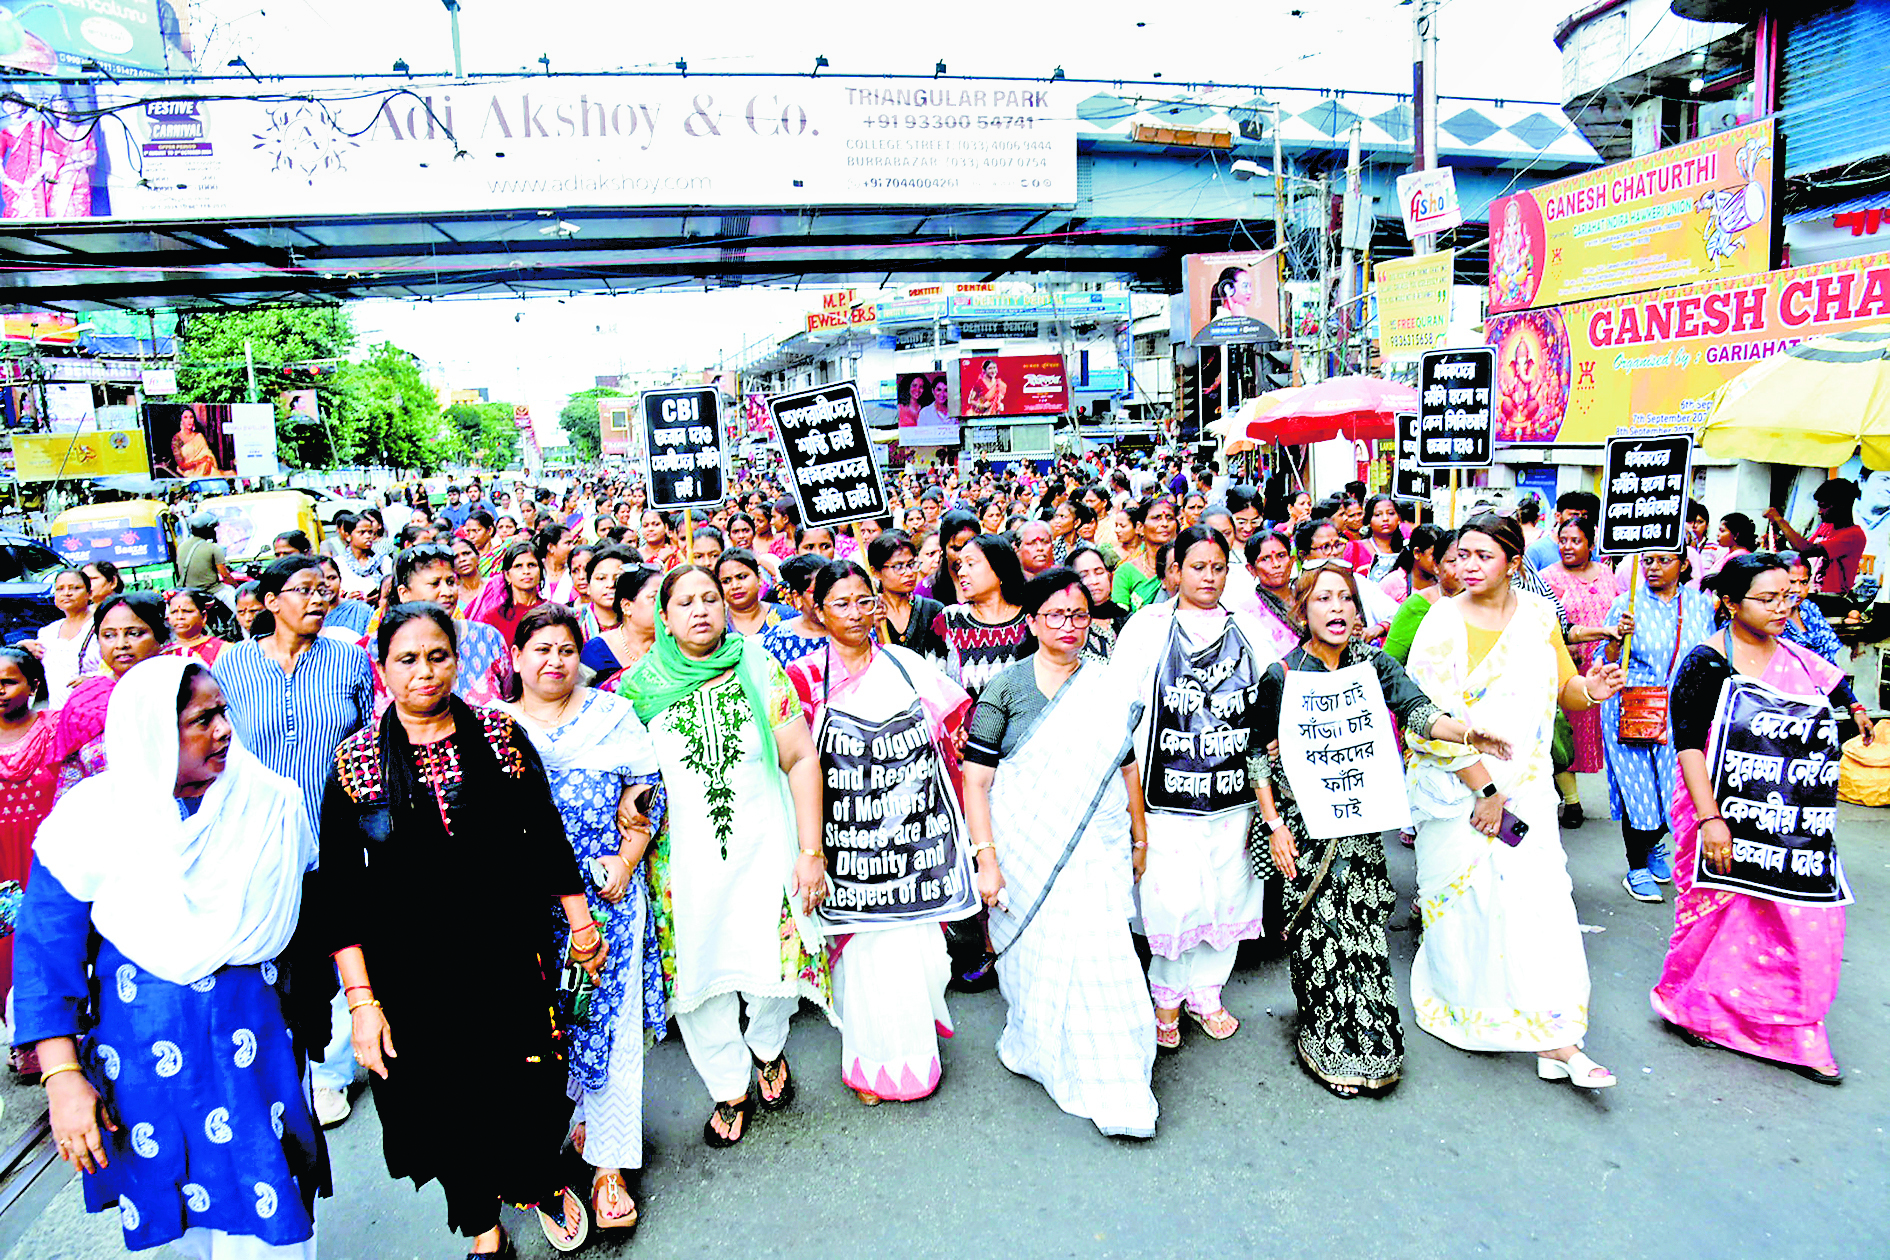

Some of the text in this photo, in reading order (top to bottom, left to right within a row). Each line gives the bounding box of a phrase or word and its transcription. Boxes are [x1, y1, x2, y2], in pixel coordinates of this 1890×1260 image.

[148, 101, 194, 115] FESTIVE
[845, 87, 1049, 108] TRIANGULAR PARK
[152, 124, 202, 138] CARNIVAL
[369, 93, 820, 151] Adi Akshoy & Co.
[863, 114, 1034, 130] +91 93300 54741
[846, 139, 902, 150] COLLEGE
[487, 175, 711, 194] www.adiakshoy.com
[1546, 153, 1717, 221] GANESH CHATURTHI
[909, 286, 943, 296] DENTITY
[956, 284, 994, 292] DENTAL
[973, 295, 1020, 305] DENTITY
[807, 306, 876, 333] JEWELLERS
[962, 321, 1036, 332] DENTITY DENTAL
[1588, 286, 1767, 348] GANESH
[1614, 348, 1671, 373] Organised
[1674, 346, 1690, 369] by
[1475, 387, 1489, 405] না
[661, 397, 700, 423] CBI
[779, 394, 856, 429] অপরাধীদের
[1633, 413, 1645, 424] 7th
[1647, 412, 1690, 425] September
[795, 422, 855, 456] শাস্তি চাই
[796, 454, 871, 487] ধর্ষকদের
[1611, 471, 1640, 494] ফাঁসি
[1667, 474, 1682, 491] না
[812, 487, 847, 514] ফাঁসি
[1608, 494, 1680, 519] কেন সিবিআই
[1612, 525, 1641, 541] জবাব
[1642, 523, 1662, 539] দাও
[1163, 676, 1206, 716] ফাঁসি
[1343, 682, 1367, 706] চাই
[1346, 709, 1373, 733] চাই
[1750, 711, 1815, 744] দেশে
[826, 727, 865, 757] The
[1160, 727, 1196, 760] কেন
[1306, 741, 1375, 765] ধর্ষকদের
[827, 764, 864, 791] and
[1164, 768, 1245, 799] জবাব দাও
[1321, 769, 1364, 792] ফাঁসি
[1724, 749, 1785, 792] সুরক্ষা
[833, 796, 851, 822] of
[855, 791, 926, 823] Mothers
[1331, 798, 1362, 819] চাই
[1720, 791, 1799, 835] কেন্দ্রীয়
[825, 812, 950, 849] Sisters are the
[836, 838, 945, 880] Dignity and
[1732, 837, 1788, 873] জবাব
[1791, 848, 1826, 876] দাও
[899, 880, 917, 904] of
[920, 878, 940, 901] us
